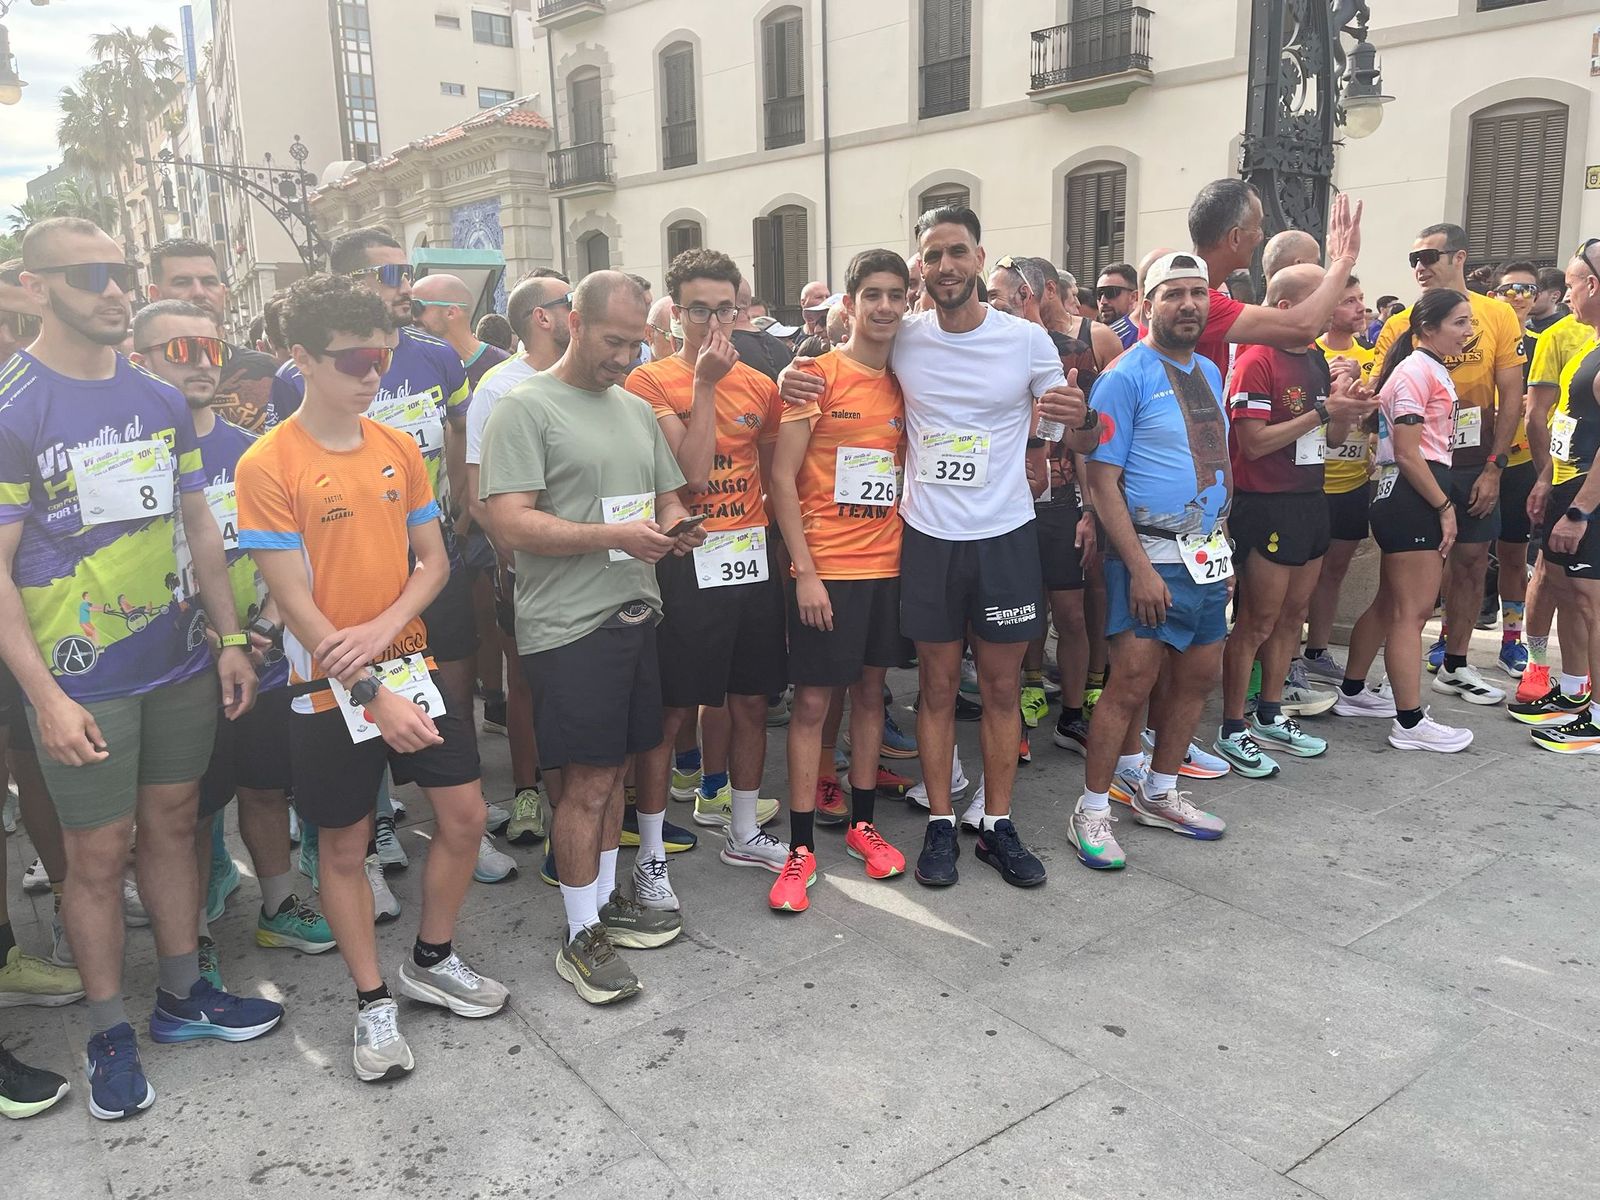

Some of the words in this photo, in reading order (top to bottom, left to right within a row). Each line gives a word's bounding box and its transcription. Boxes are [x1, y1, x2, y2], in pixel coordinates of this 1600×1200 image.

[407, 400, 420, 411] 10K
[124, 415, 144, 442] al
[137, 447, 152, 460] 10K
[1338, 444, 1362, 458] 281
[935, 461, 976, 481] 329
[140, 485, 158, 510] 8
[860, 481, 894, 502] 226
[47, 506, 71, 522] POR
[690, 502, 746, 519] TEAM
[223, 521, 239, 542] 4
[737, 533, 749, 541] 10K
[720, 560, 759, 581] 394
[1204, 556, 1228, 578] 270
[389, 665, 405, 676] 10K
